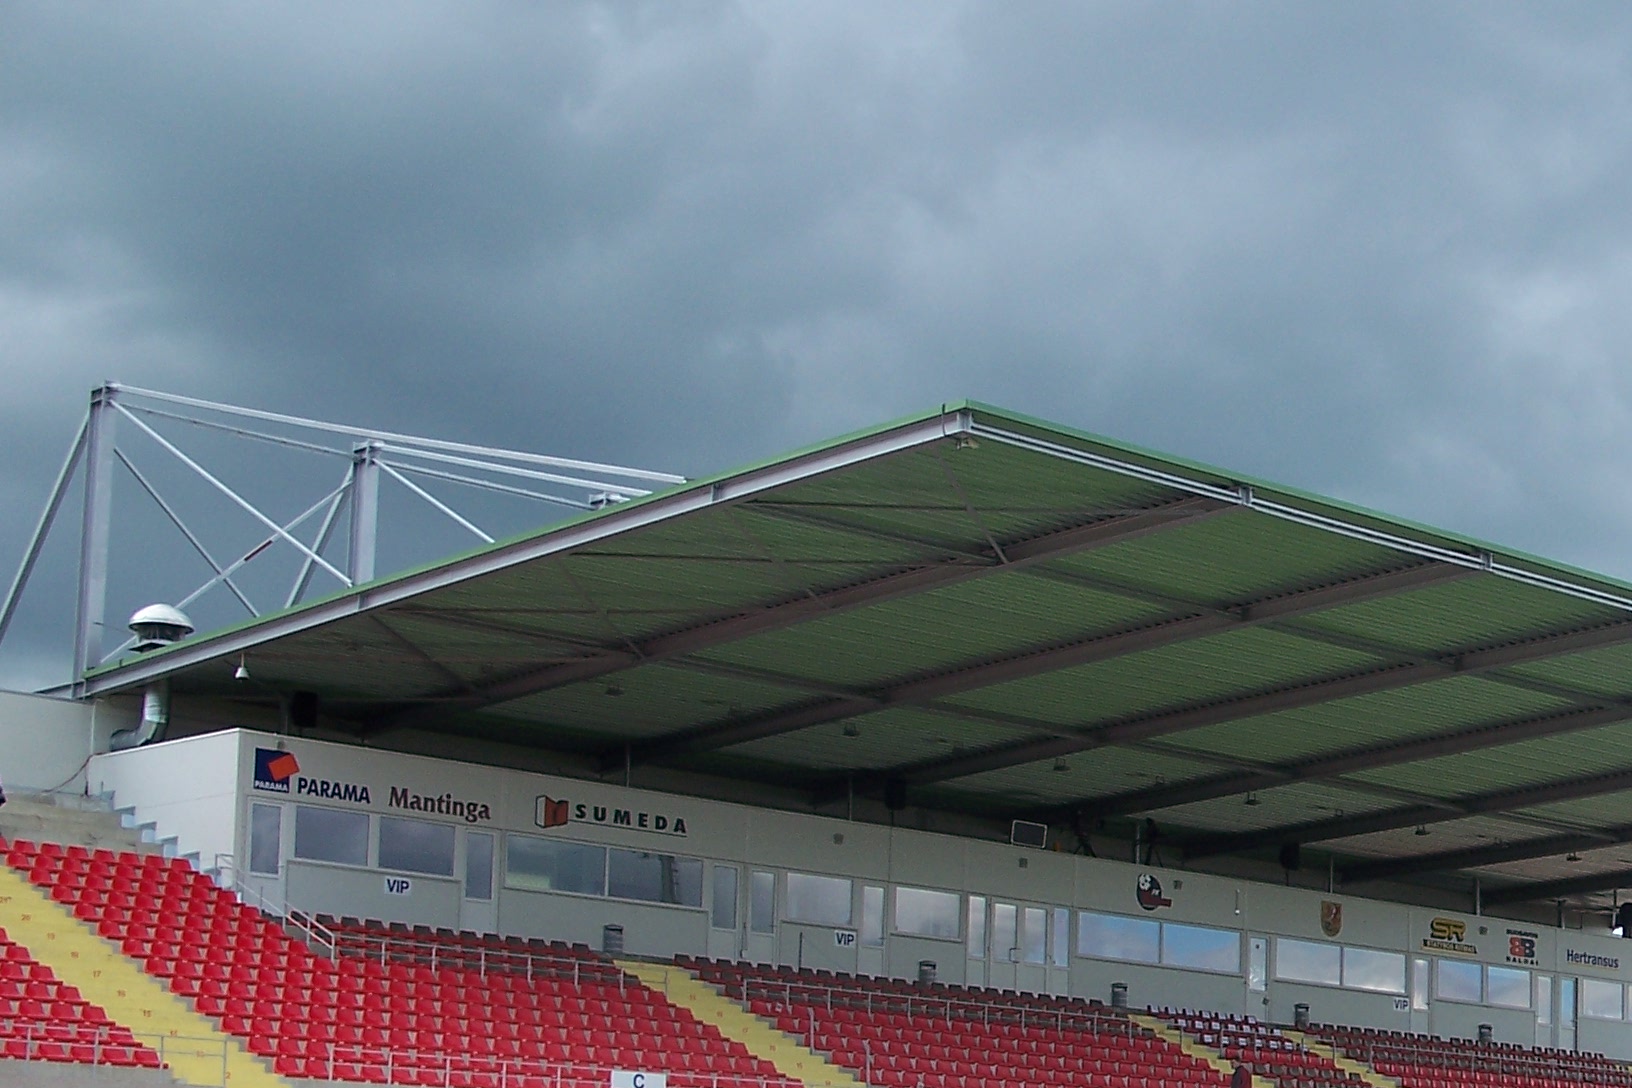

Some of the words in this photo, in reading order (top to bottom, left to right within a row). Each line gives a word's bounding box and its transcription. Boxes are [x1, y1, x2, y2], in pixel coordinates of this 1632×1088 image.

[297, 777, 371, 804] PARAMA
[388, 786, 492, 823] Mantinga
[574, 803, 687, 834] SUMEDA
[386, 878, 410, 894] VIP
[836, 932, 854, 946] VIP
[1430, 917, 1466, 943] SR
[1566, 949, 1620, 969] Hertransus
[1393, 999, 1408, 1010] VIP
[632, 1074, 645, 1088] C
